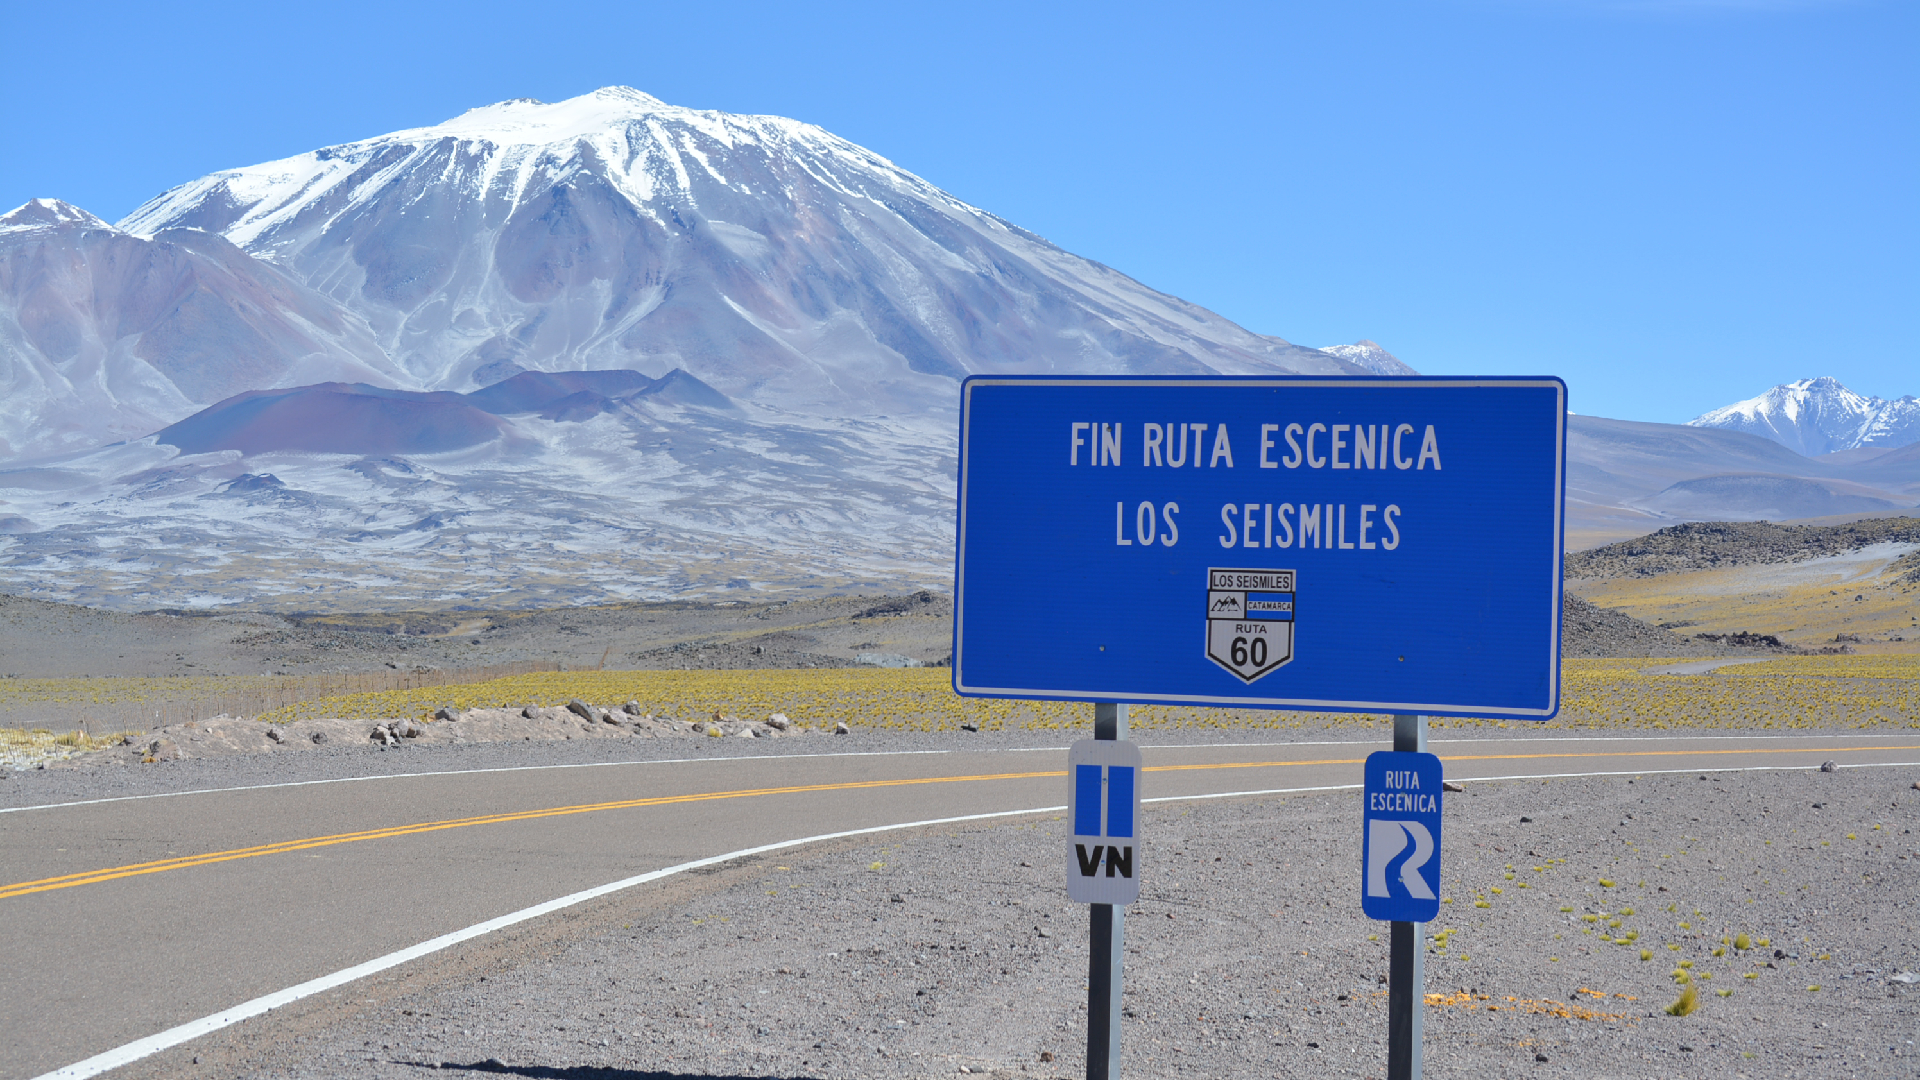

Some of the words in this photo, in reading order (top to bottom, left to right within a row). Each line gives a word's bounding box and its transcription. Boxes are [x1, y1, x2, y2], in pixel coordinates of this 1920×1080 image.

[1070, 422, 1122, 467] FIN
[1143, 422, 1234, 469] RUTA
[1259, 423, 1442, 471] ESCENICA
[1116, 501, 1179, 547] LOS
[1218, 503, 1402, 551] SEISMILES
[1213, 575, 1233, 588] LOS
[1236, 575, 1290, 589] SEISMILES
[1248, 601, 1292, 611] CATAMARCA
[1235, 624, 1267, 634] RUTA
[1230, 636, 1268, 668] 60
[1385, 770, 1420, 790] RUTA
[1370, 792, 1437, 813] ESCENICA
[1075, 843, 1133, 879] VN
